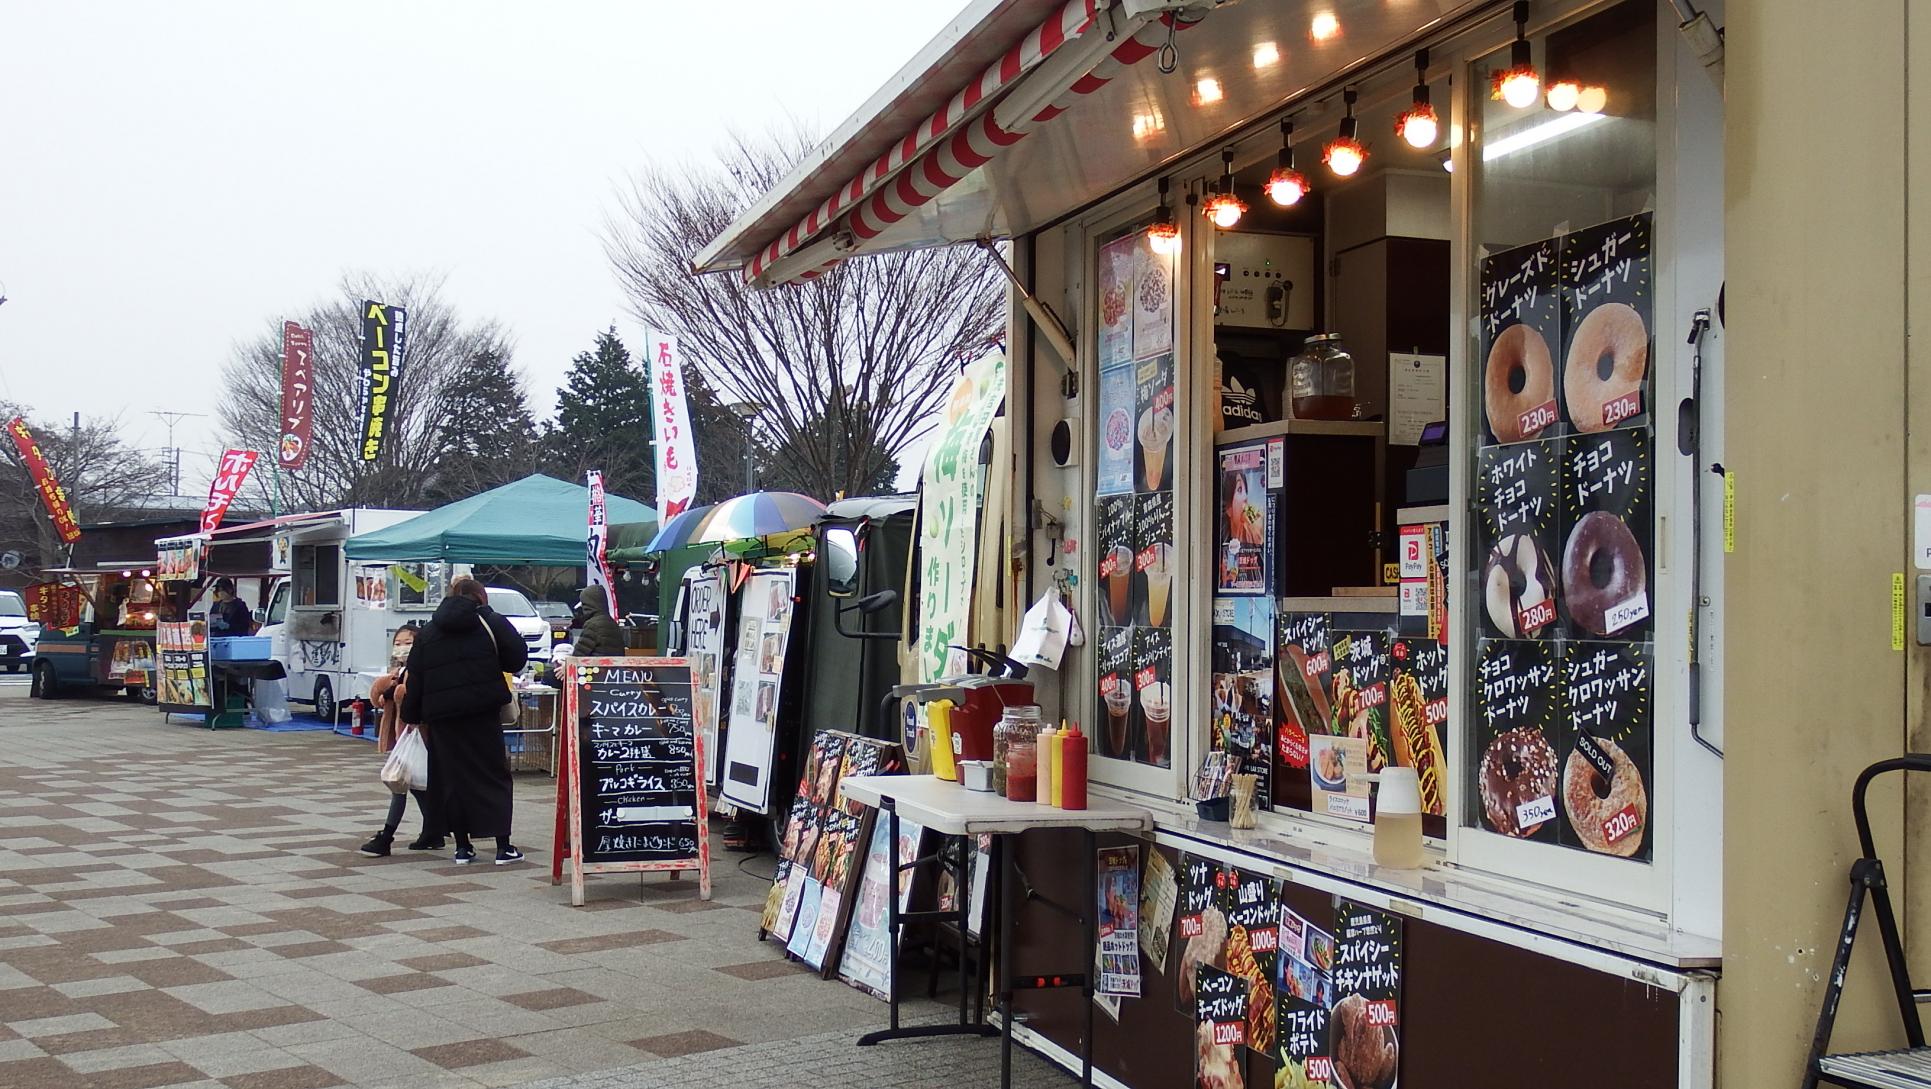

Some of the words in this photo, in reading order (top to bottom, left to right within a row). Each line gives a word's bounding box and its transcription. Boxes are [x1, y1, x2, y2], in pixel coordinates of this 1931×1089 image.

[1570, 232, 1632, 282] シュガー
[1486, 247, 1551, 308] グレーズド
[1575, 258, 1632, 310] ドーナツ
[1489, 285, 1538, 334] ドーナツ
[364, 303, 390, 460] ベーコン串焼き
[657, 341, 679, 470] 石焼きいも
[1222, 403, 1263, 424] adidas
[1604, 398, 1637, 423] 230円
[1521, 407, 1555, 433] 230円
[1491, 448, 1537, 485] ホワイト
[1573, 440, 1614, 478] チョコ
[1493, 479, 1526, 509] チョコ
[1577, 460, 1634, 506] ドーナツ
[1498, 496, 1542, 533] ドーナツ
[1144, 523, 1167, 546] ジュース
[1101, 558, 1117, 577] 300円
[1137, 550, 1155, 570] 300円
[1405, 562, 1422, 573] PayPay
[691, 585, 712, 614] ORDER
[1283, 615, 1324, 644] スパイシー
[1521, 604, 1553, 630] 280円
[691, 618, 709, 650] HERE
[1144, 631, 1161, 649] アイス
[1302, 627, 1326, 654] ドッグ
[1306, 655, 1328, 676] 600円
[1416, 639, 1446, 671] ホット
[1481, 654, 1511, 679] チョコ
[1567, 649, 1619, 682] シュガー
[603, 669, 653, 684] MENU
[1138, 670, 1154, 689] 300円
[1352, 655, 1381, 682] ドッグ
[1419, 665, 1448, 696] ドッグ
[609, 689, 642, 700] Curry
[1101, 676, 1116, 692] 400円
[1484, 665, 1553, 702] クロワッサン
[1568, 667, 1646, 706] クロワッサン
[590, 700, 667, 717] スパイスカレー
[1359, 686, 1384, 709] 700円
[1486, 695, 1529, 727] ドーナツ
[1571, 700, 1617, 731] ドーナツ
[1579, 736, 1598, 760] SOLD
[1597, 754, 1612, 774] OUT
[617, 796, 646, 804] Chicken
[1604, 812, 1638, 842] 320円
[1190, 862, 1208, 885] ツナ
[1188, 885, 1213, 911] ドッグ
[1238, 880, 1264, 905] 山盛り
[1228, 897, 1279, 926] ベーコンドッグ
[1181, 918, 1202, 936] 700円
[1251, 930, 1277, 951] 1000円
[1339, 940, 1390, 964] スパイシー
[1202, 976, 1233, 993] ベーコン
[1335, 962, 1399, 992] チキンナゲット
[1198, 994, 1246, 1020] チーズドッグ
[1368, 1003, 1396, 1024] 500円
[1216, 1024, 1243, 1043] 1200円
[1288, 1009, 1325, 1032] フライド
[1290, 1033, 1319, 1056] ポテト
